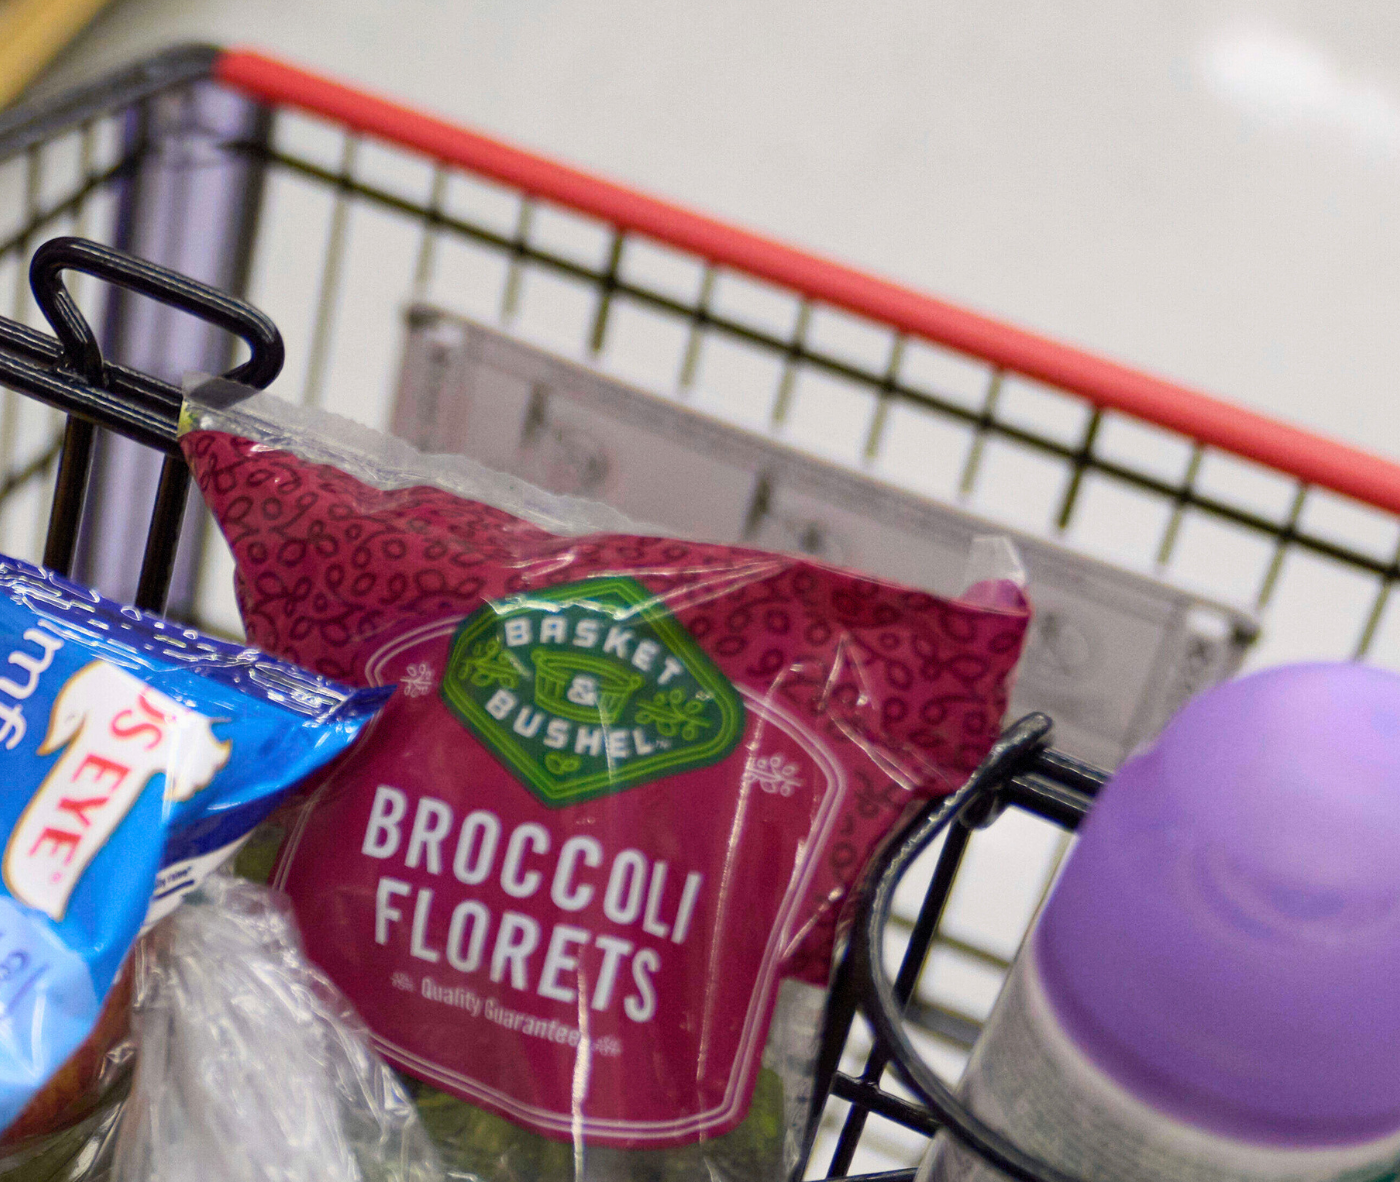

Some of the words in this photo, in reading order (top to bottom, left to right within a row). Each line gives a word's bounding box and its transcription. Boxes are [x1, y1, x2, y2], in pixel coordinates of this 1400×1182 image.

[505, 615, 684, 684] BASKET
[485, 689, 654, 758] BUSHEL
[566, 674, 599, 706] &
[28, 753, 132, 867] EYE
[362, 787, 702, 944] BROCCOLI
[375, 879, 661, 1023] FLORETS
[421, 976, 482, 1018] Quality
[484, 996, 588, 1047] Guarantee
